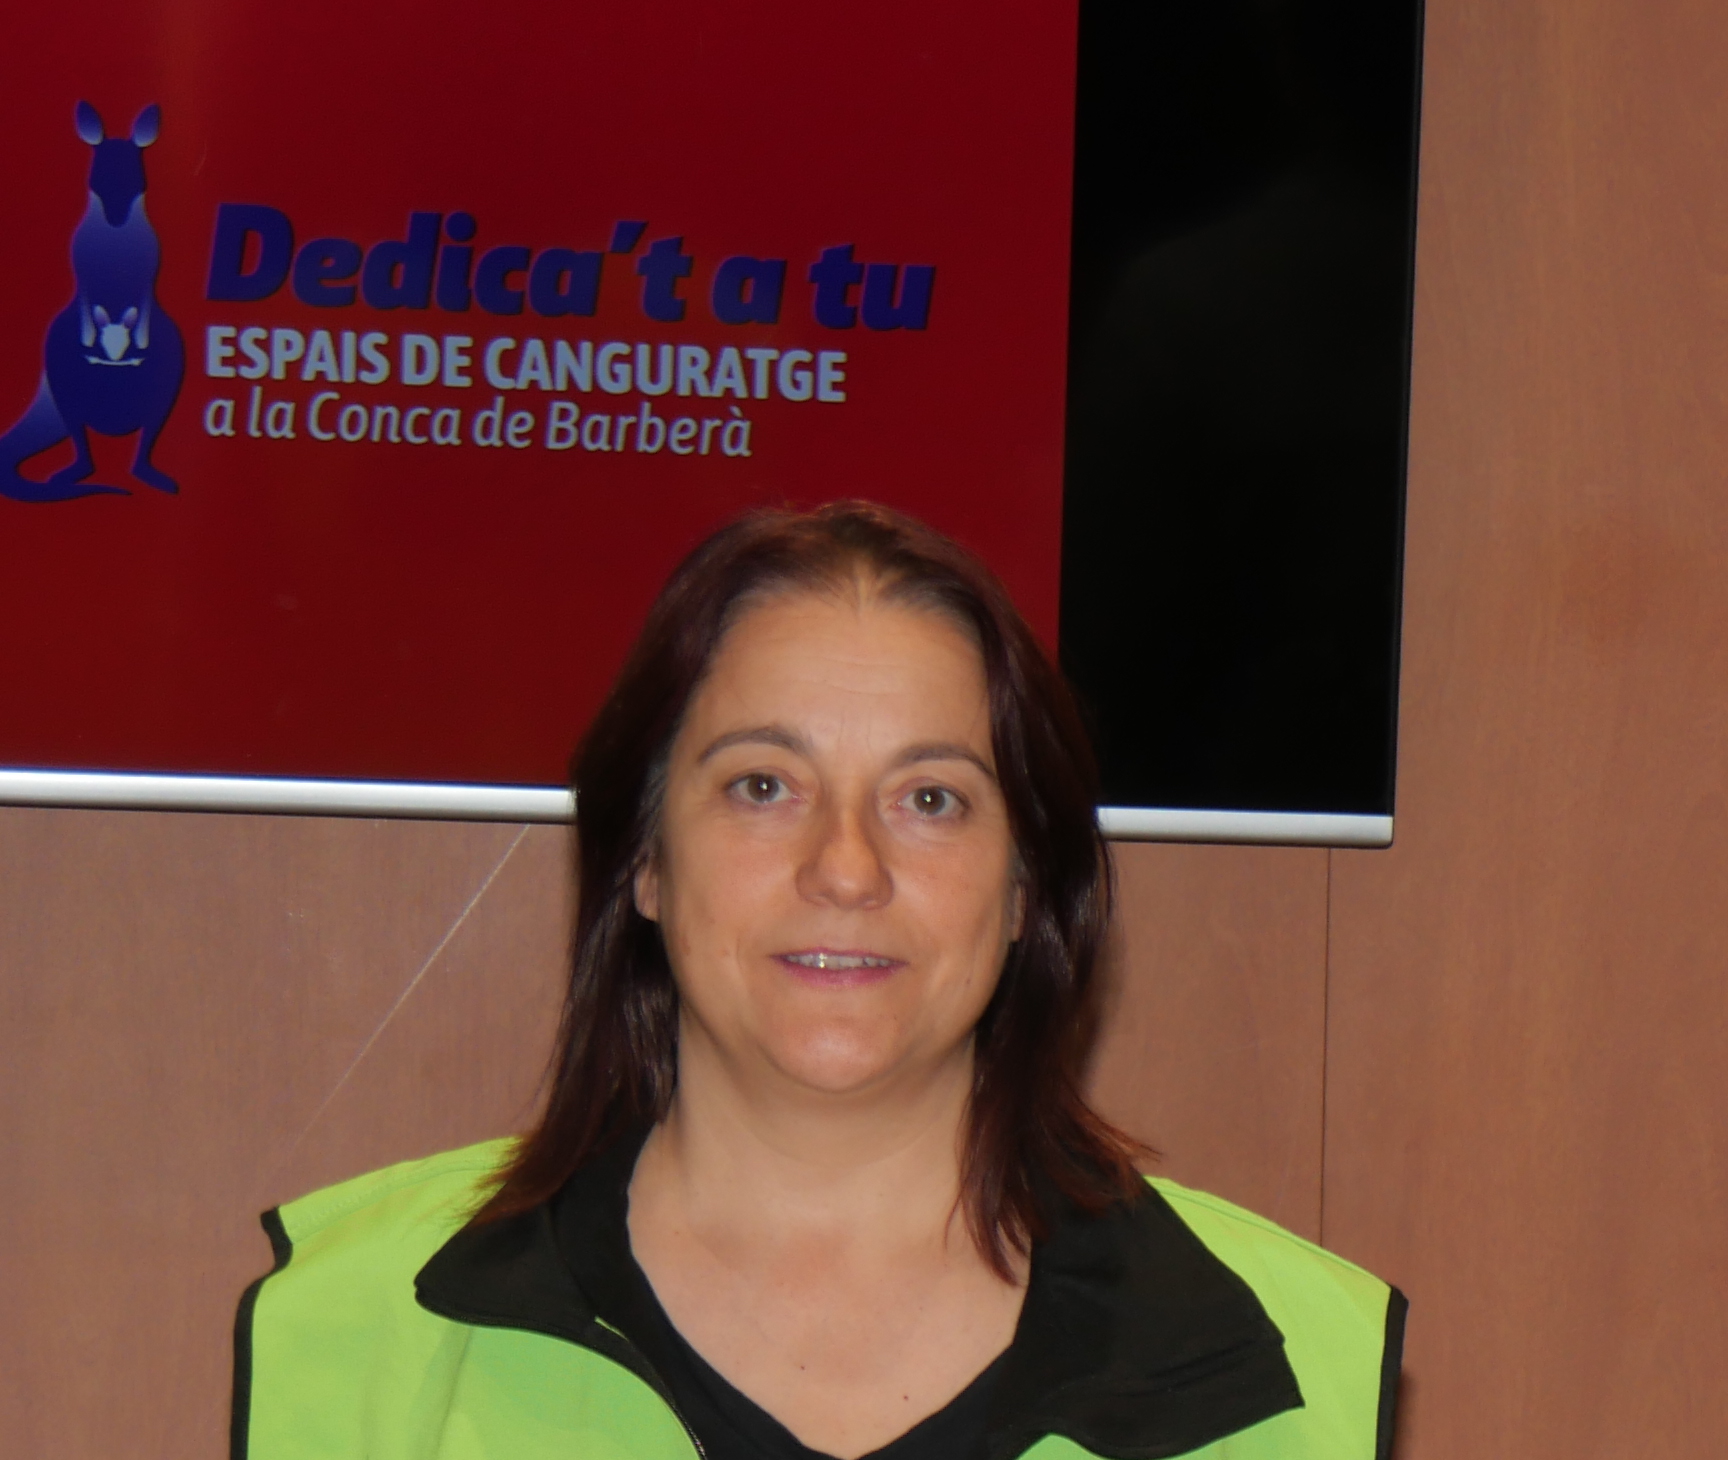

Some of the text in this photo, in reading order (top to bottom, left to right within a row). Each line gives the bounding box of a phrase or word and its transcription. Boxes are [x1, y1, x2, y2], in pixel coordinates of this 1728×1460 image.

[206, 203, 936, 331] Dedica't a tu
[207, 326, 846, 402] ESPAIS DE CANGURATGE
[204, 386, 751, 456] a la Conca de Barberà
